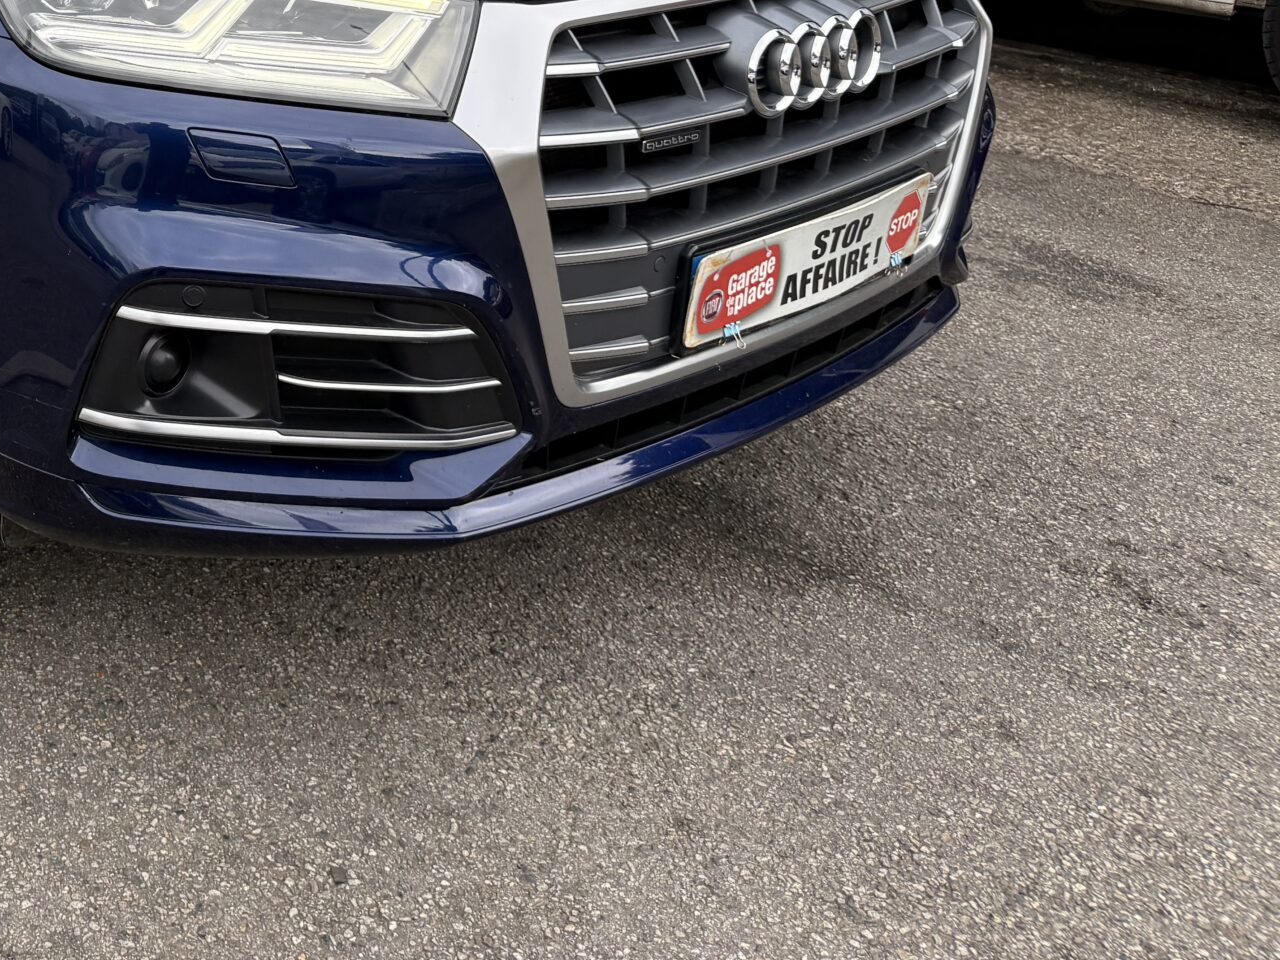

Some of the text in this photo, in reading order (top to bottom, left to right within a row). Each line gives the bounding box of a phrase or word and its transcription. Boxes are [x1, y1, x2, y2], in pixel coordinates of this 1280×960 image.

[646, 133, 699, 151] quattro
[811, 213, 874, 260] STOP
[888, 209, 919, 236] STOP
[728, 256, 776, 296] Garage
[780, 242, 872, 305] AFFAIRE
[734, 277, 774, 316] place
